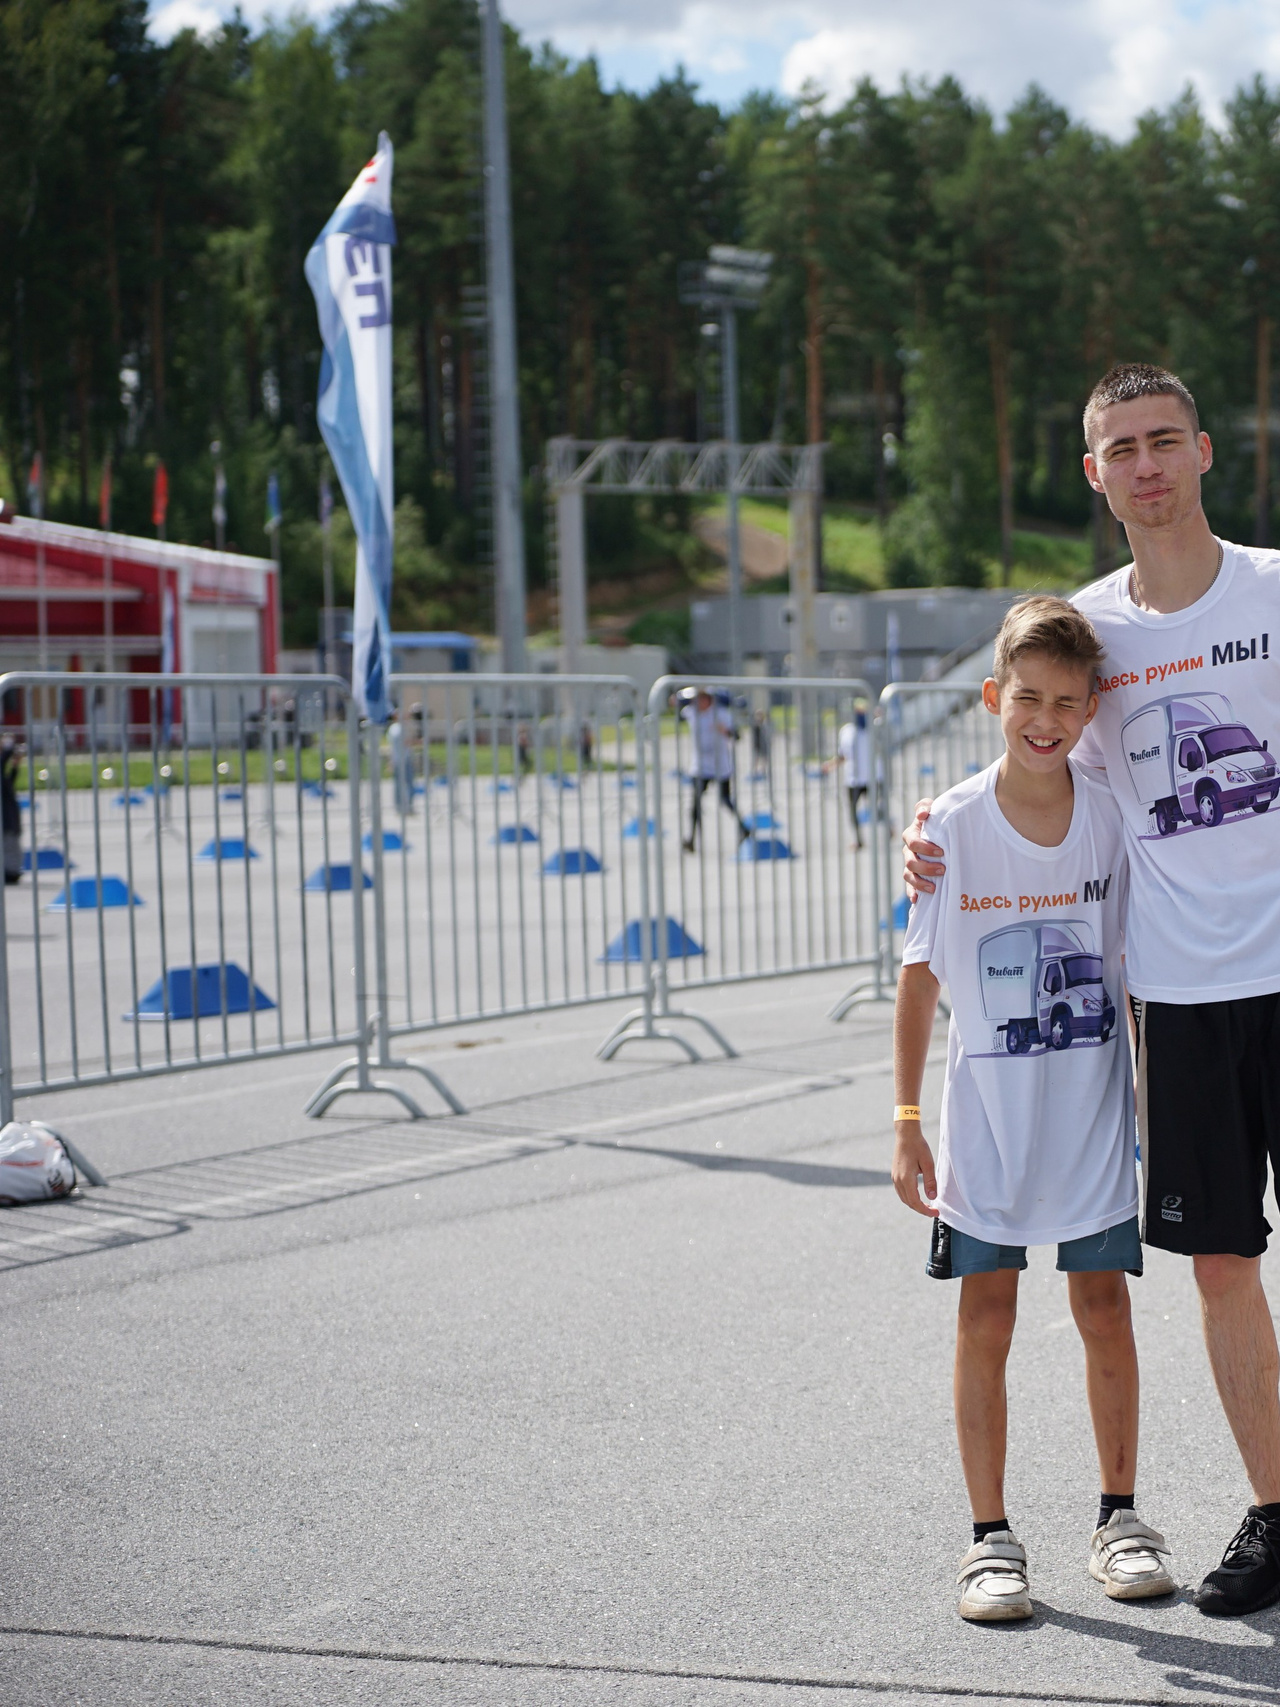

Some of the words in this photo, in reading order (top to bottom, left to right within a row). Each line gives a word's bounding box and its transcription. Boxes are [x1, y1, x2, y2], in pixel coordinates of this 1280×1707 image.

[1097, 670, 1140, 693] Здесь
[1145, 655, 1204, 685] рулим
[1211, 633, 1270, 667] МЫ!
[959, 893, 1012, 912] Здесь
[1018, 892, 1078, 913] рулим
